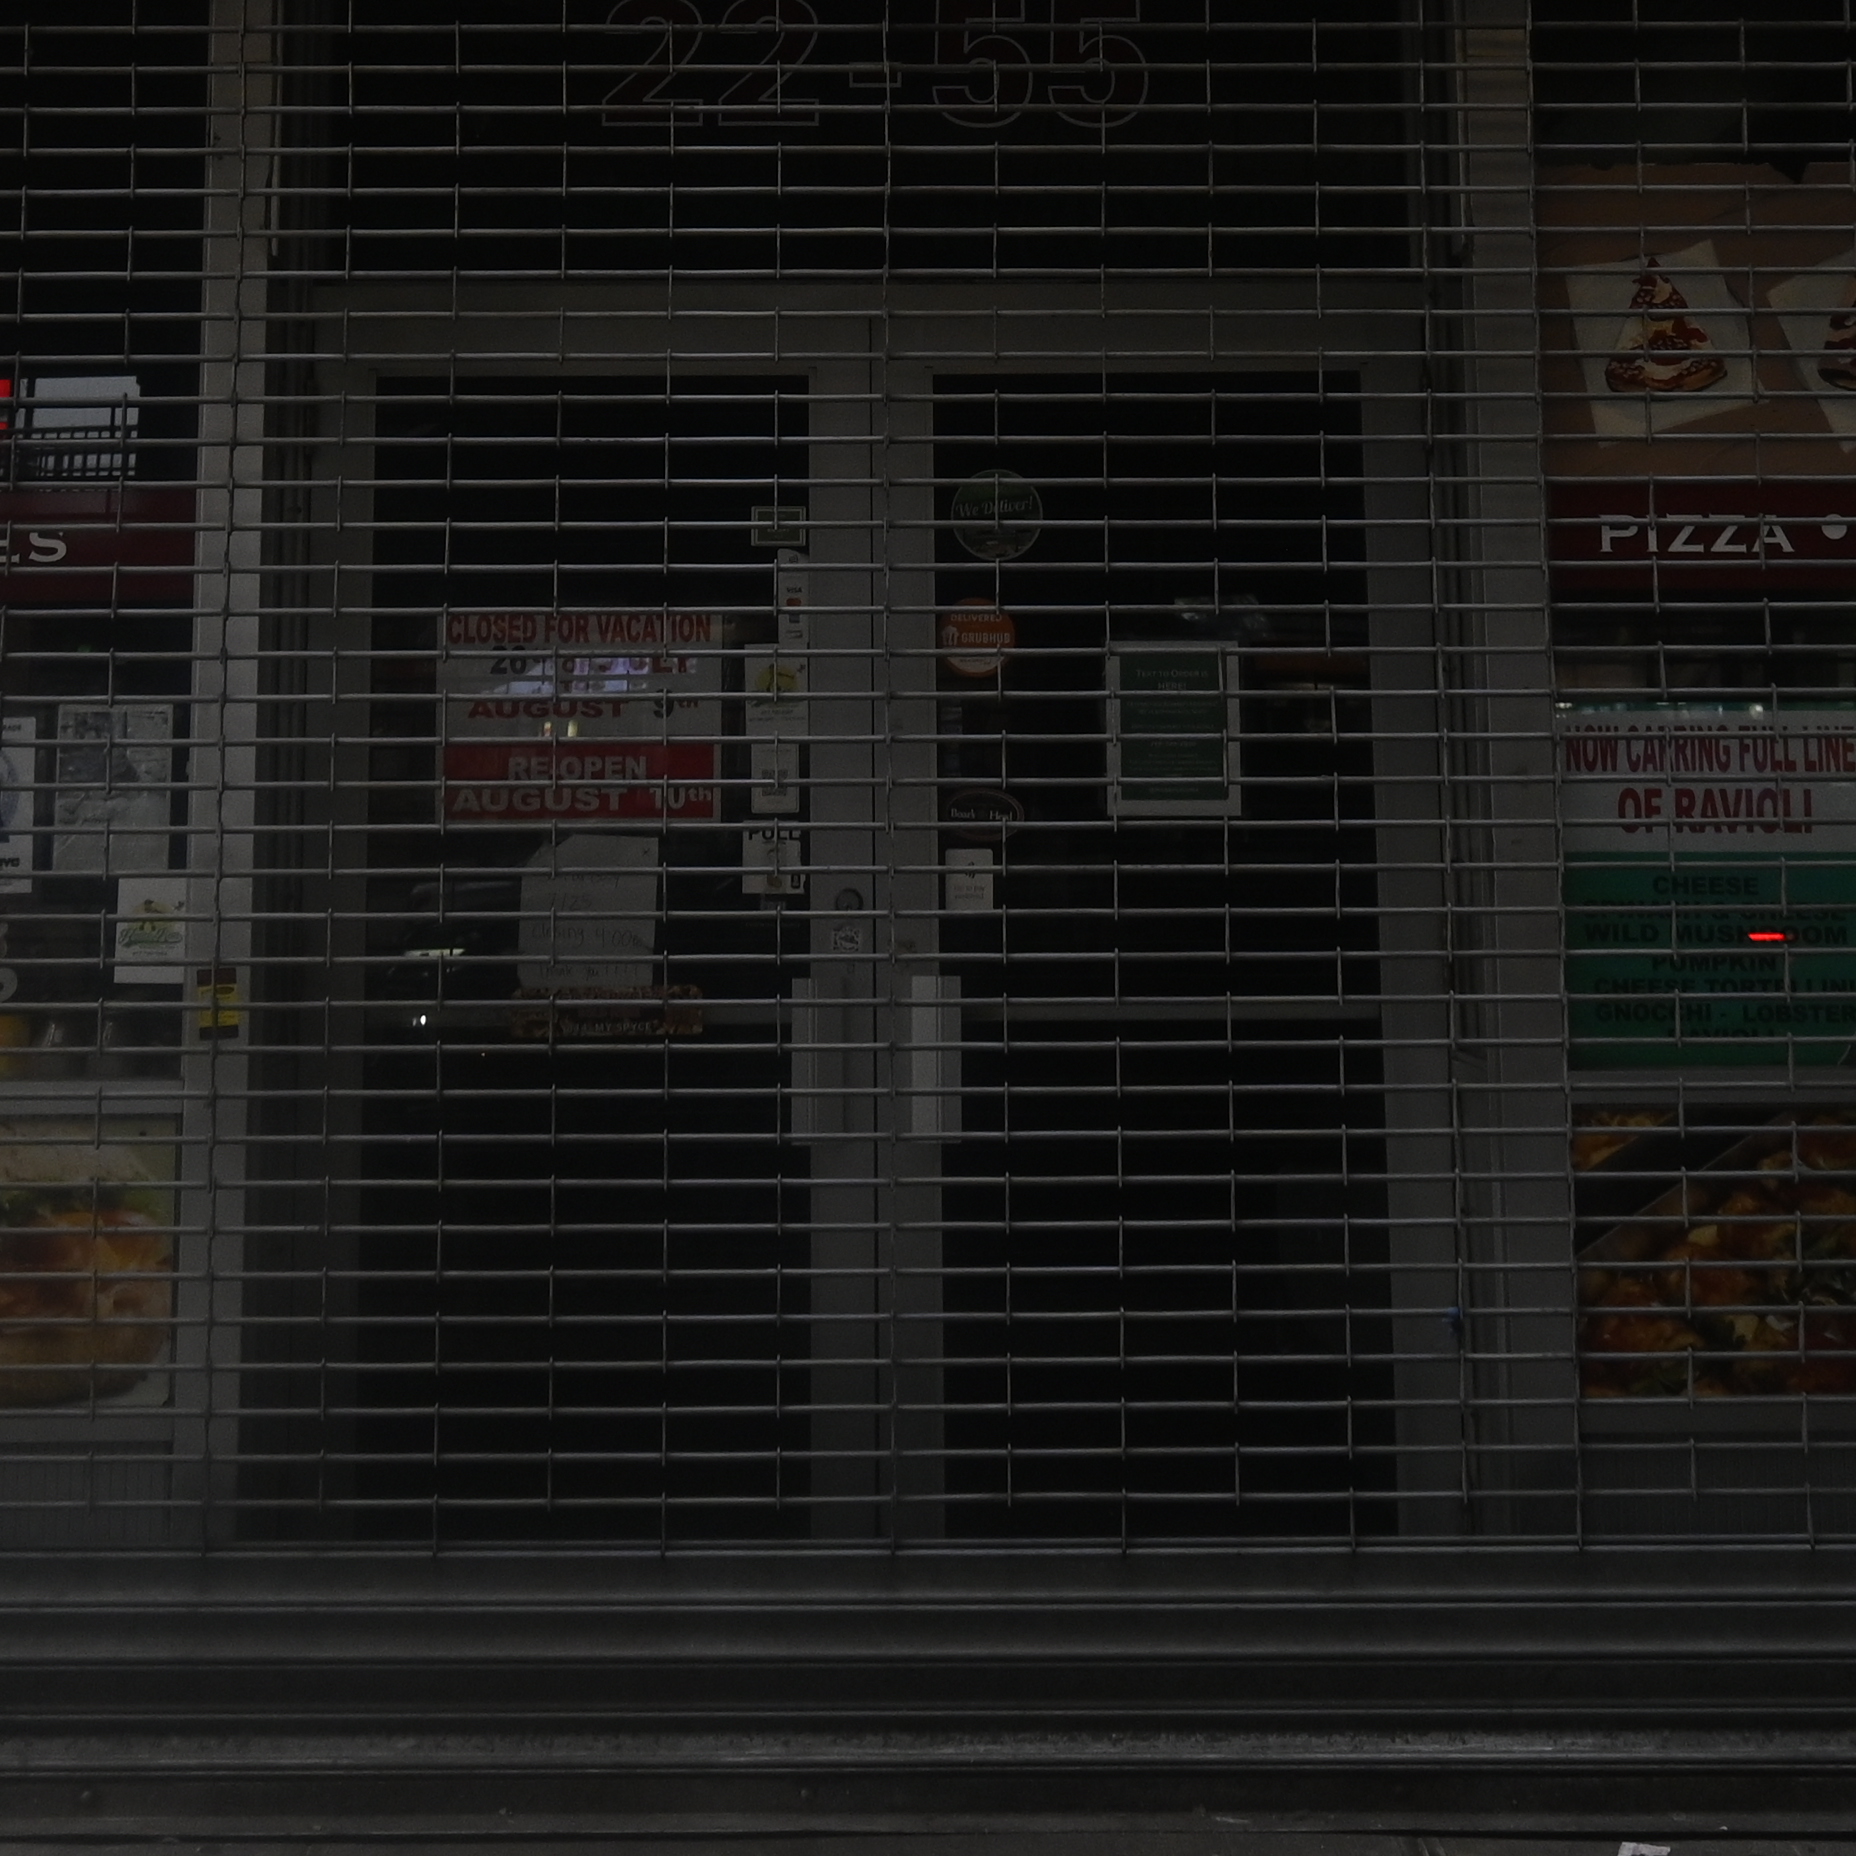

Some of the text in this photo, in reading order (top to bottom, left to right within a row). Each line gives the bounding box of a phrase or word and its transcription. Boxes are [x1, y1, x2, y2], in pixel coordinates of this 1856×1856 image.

[955, 502, 980, 518] We
[1599, 513, 1796, 554] PIZZA
[446, 613, 713, 646] CLOSED FOR VACATION
[961, 632, 1011, 644] GRUBHUB
[467, 699, 630, 719] AUGUST
[1565, 725, 1856, 773] NOW CARRING FULL LINE
[451, 788, 629, 812] AUGUST
[1617, 787, 1814, 833] OF RAVIOLI
[1652, 875, 1759, 896] CHEESE
[1585, 923, 1660, 944] WILD
[1651, 951, 1777, 972] PUMPKIN
[1595, 1003, 1712, 1023] GNOCCHI
